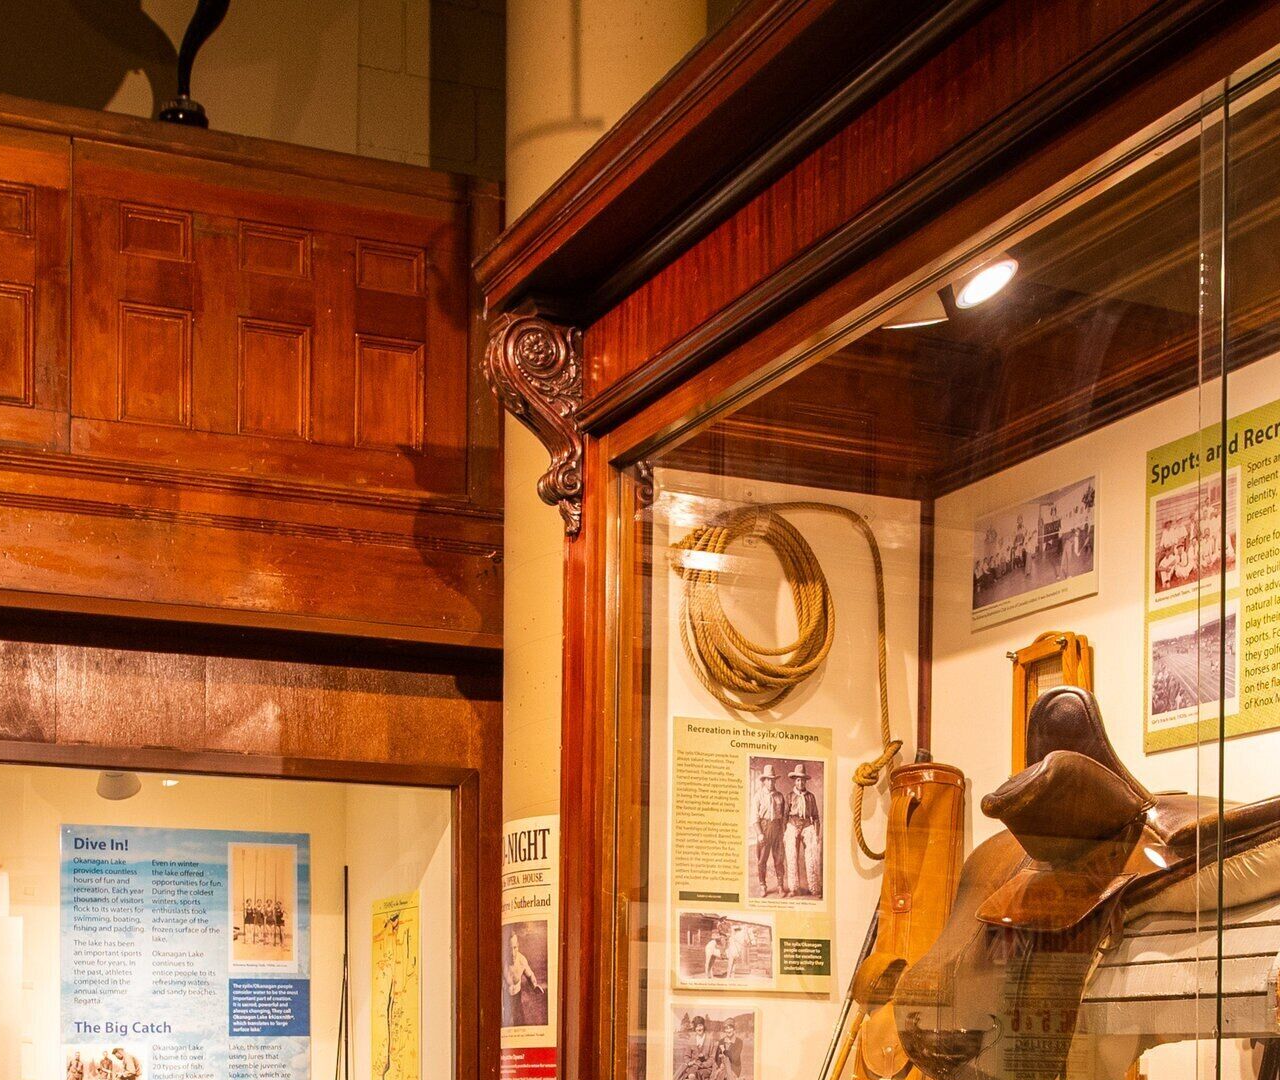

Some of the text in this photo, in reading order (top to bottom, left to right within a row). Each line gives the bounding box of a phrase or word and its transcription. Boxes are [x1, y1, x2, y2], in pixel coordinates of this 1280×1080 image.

[1246, 457, 1271, 473] Sports
[1246, 470, 1278, 488] element
[1245, 488, 1277, 508] identity,
[1246, 504, 1277, 523] present.
[687, 724, 818, 742] Recreation in the syilx/Okanagan
[729, 739, 777, 752] Community
[74, 837, 128, 851] Dive In!
[72, 856, 109, 866] Okanagan
[522, 873, 544, 884] HOUSE
[514, 893, 551, 910] Sutherland
[73, 1020, 171, 1036] The Big Catch
